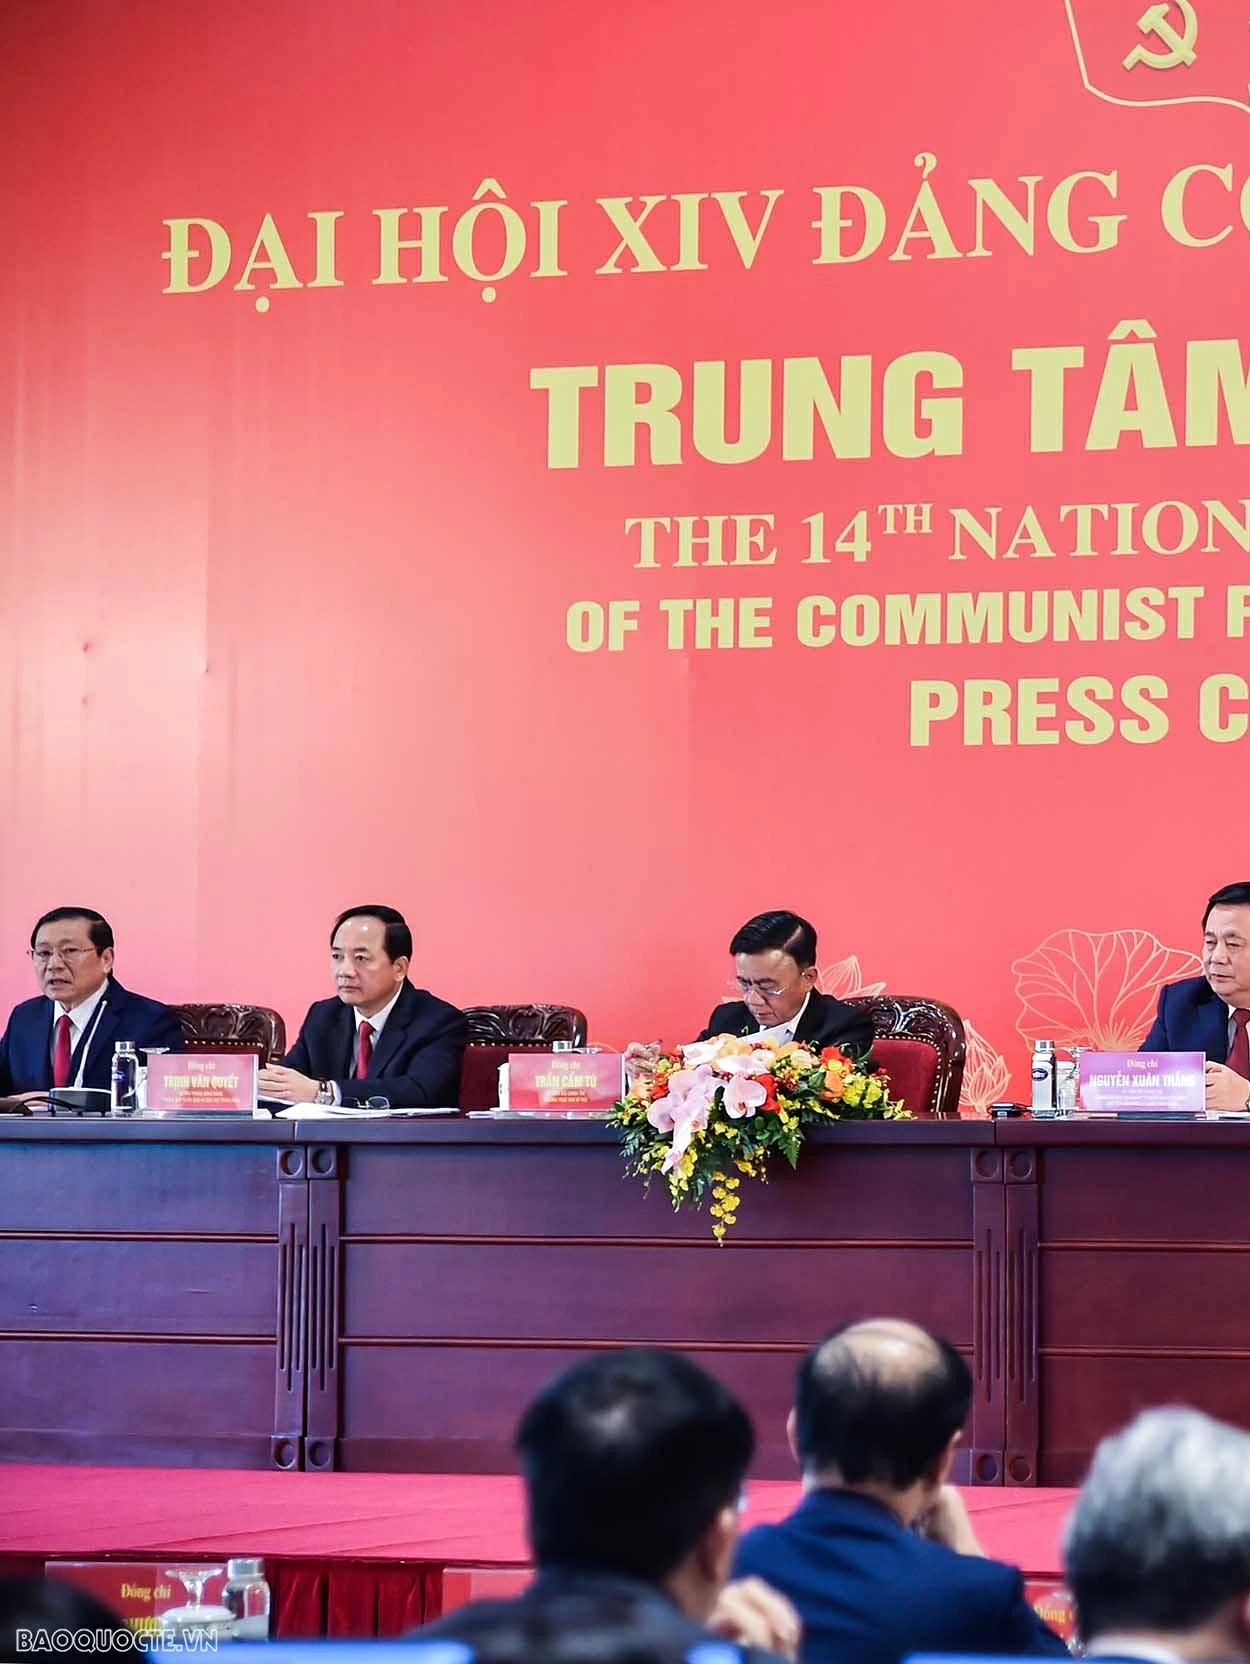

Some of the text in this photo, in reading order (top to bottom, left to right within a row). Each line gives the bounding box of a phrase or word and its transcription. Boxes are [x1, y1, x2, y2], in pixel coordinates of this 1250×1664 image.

[162, 212, 344, 312] ĐẠI
[372, 179, 567, 302] HỘI
[596, 190, 784, 274] XIV
[812, 153, 1126, 264] ĐẢNG
[530, 351, 963, 469] TRUNG
[625, 514, 777, 568] THE
[802, 504, 932, 563] 14TH
[567, 600, 640, 652] OF
[660, 597, 772, 649] THE
[797, 587, 1204, 647] COMMUNIST
[910, 675, 1169, 746] PRESS
